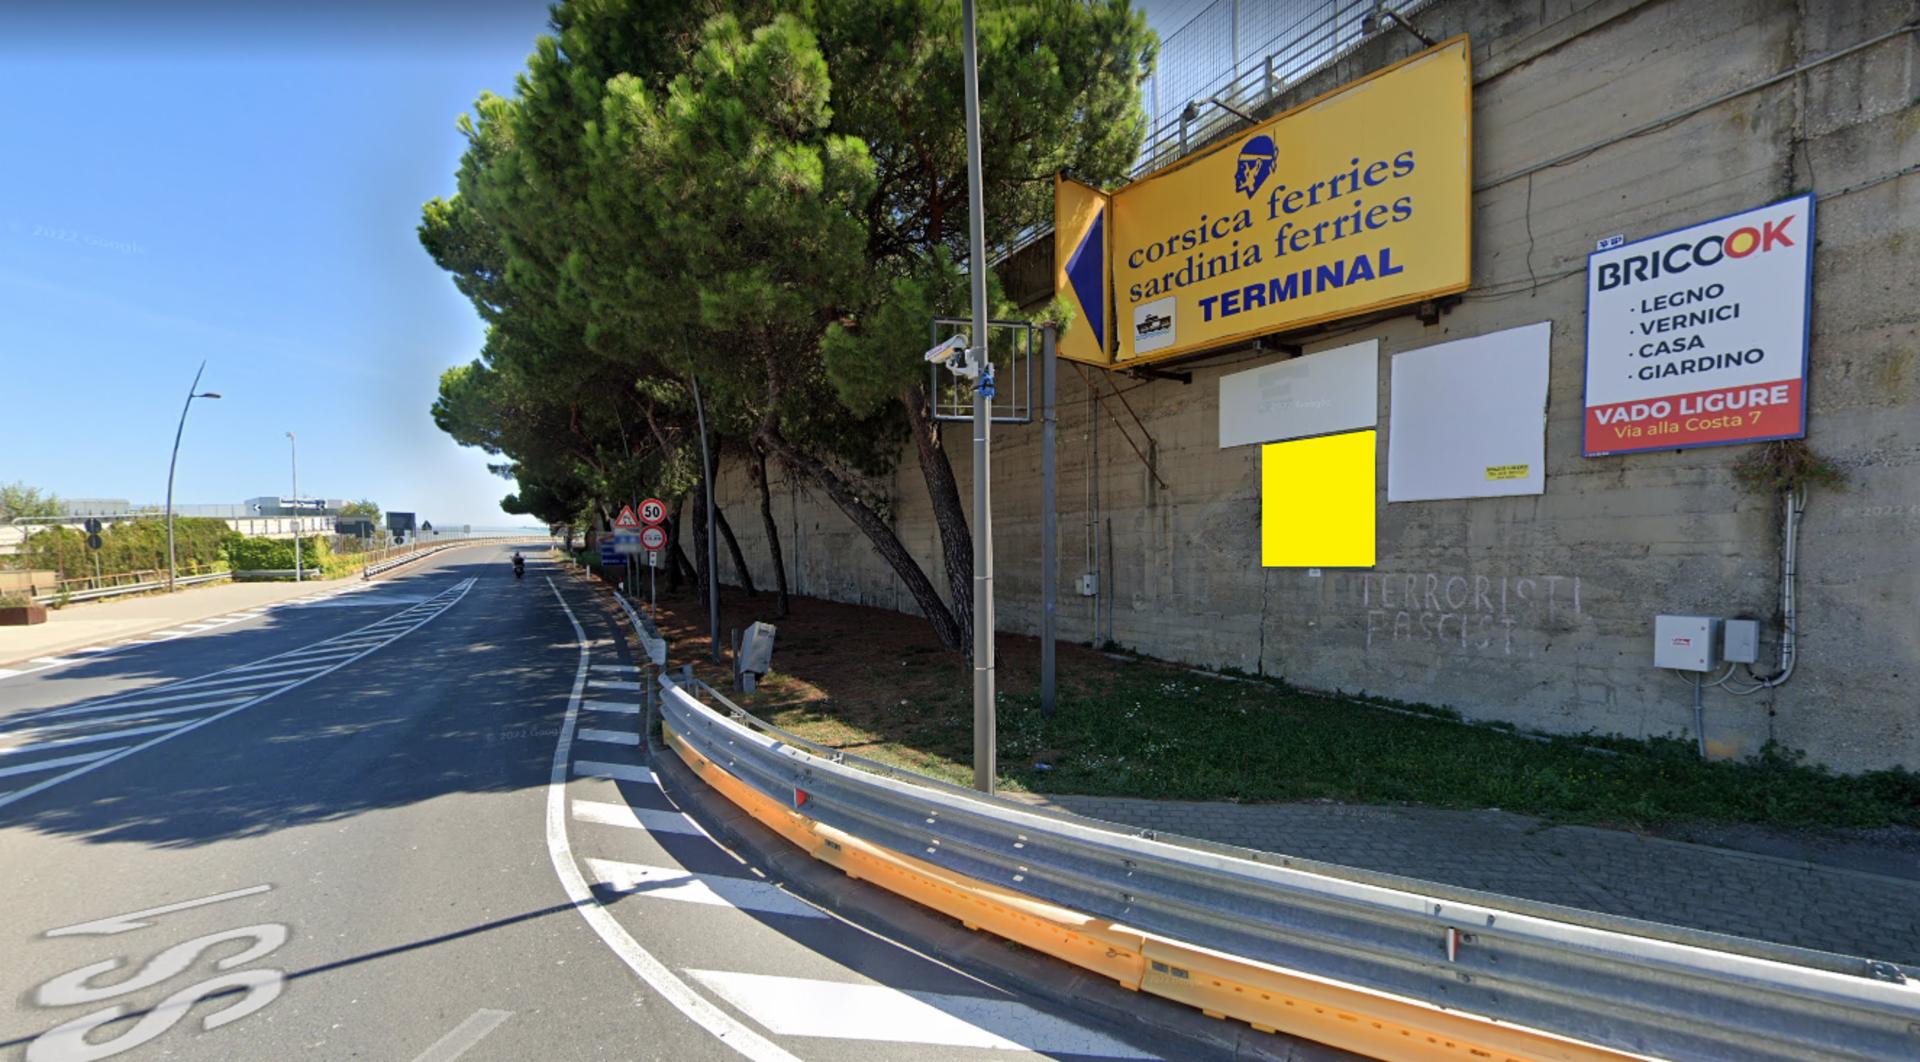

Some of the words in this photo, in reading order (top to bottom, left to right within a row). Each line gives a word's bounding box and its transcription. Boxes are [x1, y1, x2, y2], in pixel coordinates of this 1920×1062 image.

[1128, 209, 1253, 270] corsica
[1267, 150, 1415, 221] ferries
[1129, 240, 1263, 303] sardinia
[1275, 196, 1412, 258] ferries
[1199, 247, 1403, 322] TERMINAL
[1641, 283, 1724, 314] LEGNO
[1640, 303, 1740, 336] VERNICI
[1639, 334, 1705, 358] CASA
[1638, 348, 1764, 381] GIARDINO
[1594, 401, 1671, 425] VADO
[1680, 385, 1789, 415] LIGURE
[1615, 425, 1642, 439] Via
[1648, 420, 1680, 436] alla
[1685, 412, 1743, 432] Costa
[1749, 410, 1763, 425] 7
[644, 506, 661, 518] 50
[1360, 573, 1582, 616] TERRORISTI
